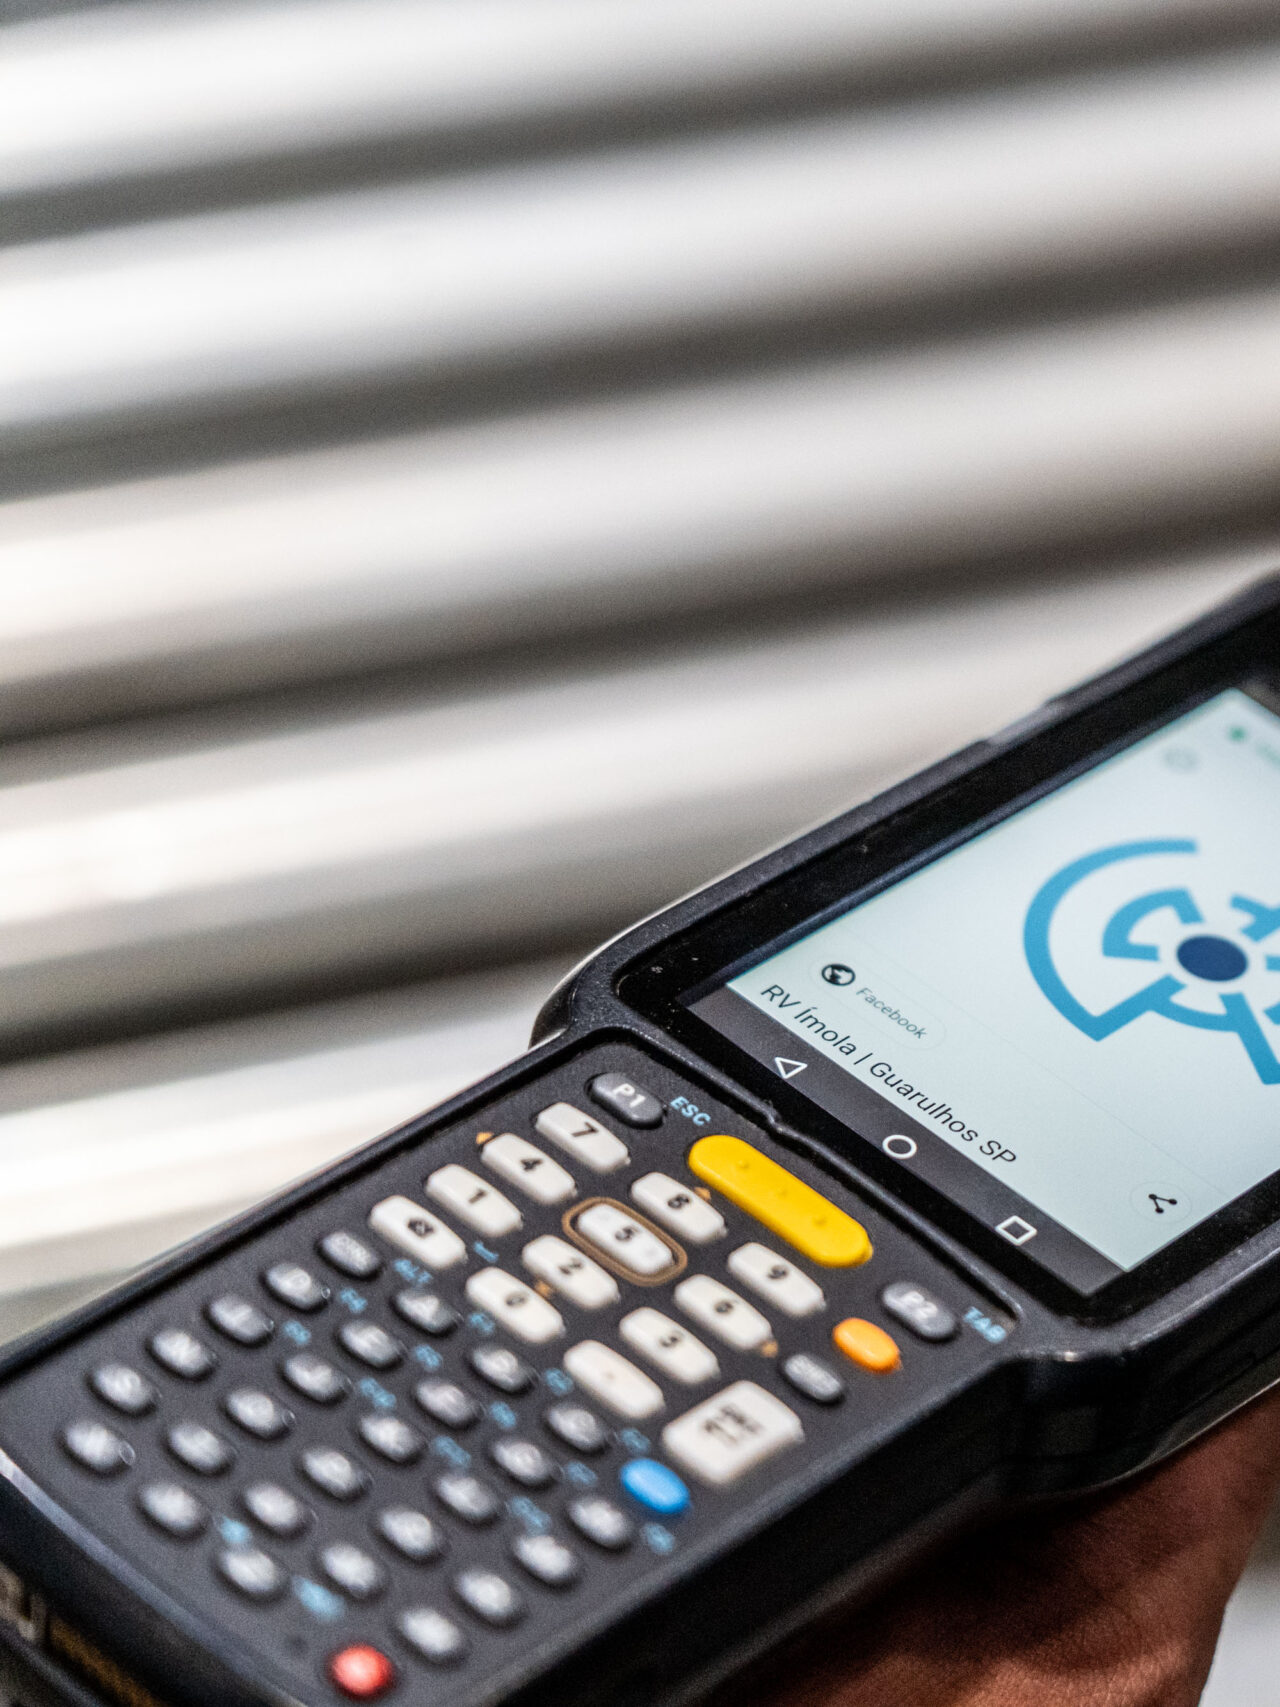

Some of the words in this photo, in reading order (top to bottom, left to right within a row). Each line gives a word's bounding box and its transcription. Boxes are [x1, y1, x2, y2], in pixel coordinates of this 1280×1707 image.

[856, 987, 927, 1039] Facebook
[760, 984, 801, 1009] RV
[794, 1006, 857, 1056] Ímola
[869, 1062, 978, 1142] Guarulhos
[979, 1139, 1017, 1165] SP
[611, 1082, 646, 1109] P1
[669, 1095, 711, 1126] ESC
[571, 1122, 599, 1138] 7
[520, 1158, 543, 1172] 4
[614, 1225, 640, 1242] 5
